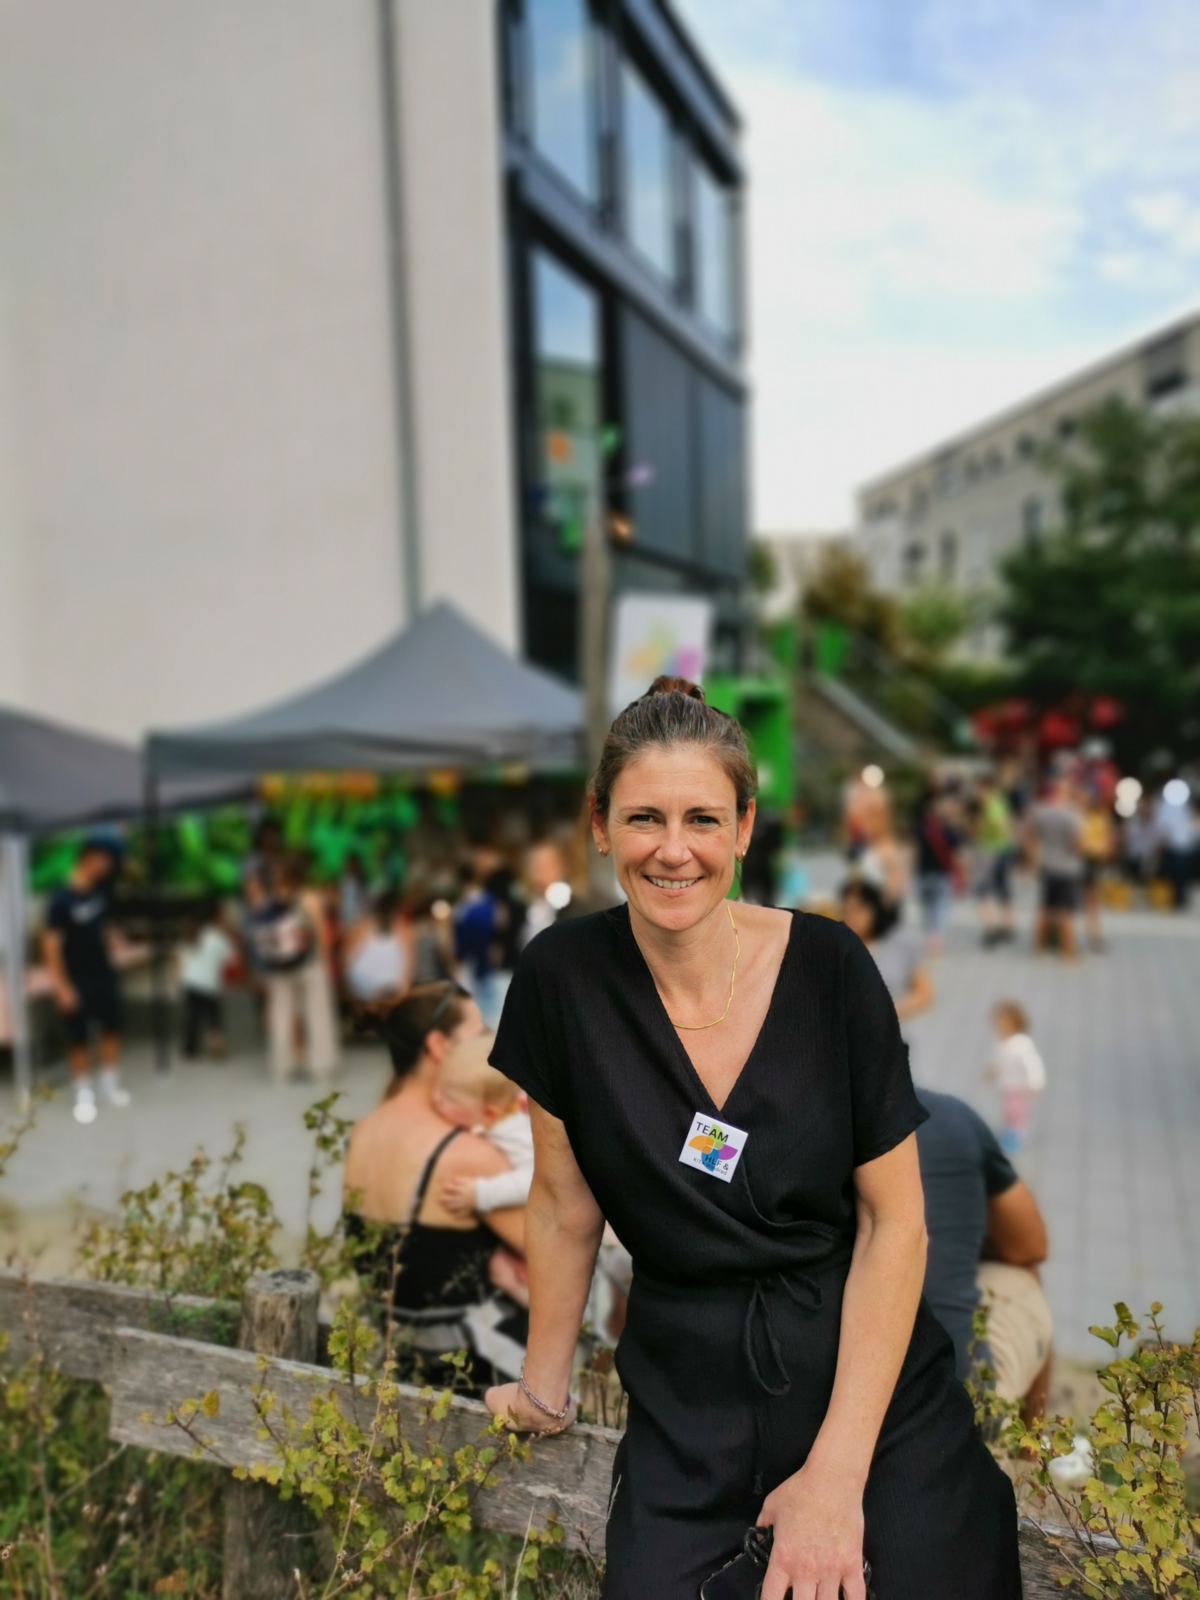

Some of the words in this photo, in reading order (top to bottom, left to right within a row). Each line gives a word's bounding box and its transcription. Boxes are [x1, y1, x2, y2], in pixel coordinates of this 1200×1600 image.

[696, 1121, 729, 1143] TEAM
[705, 1155, 723, 1167] HLF
[723, 1163, 729, 1171] &
